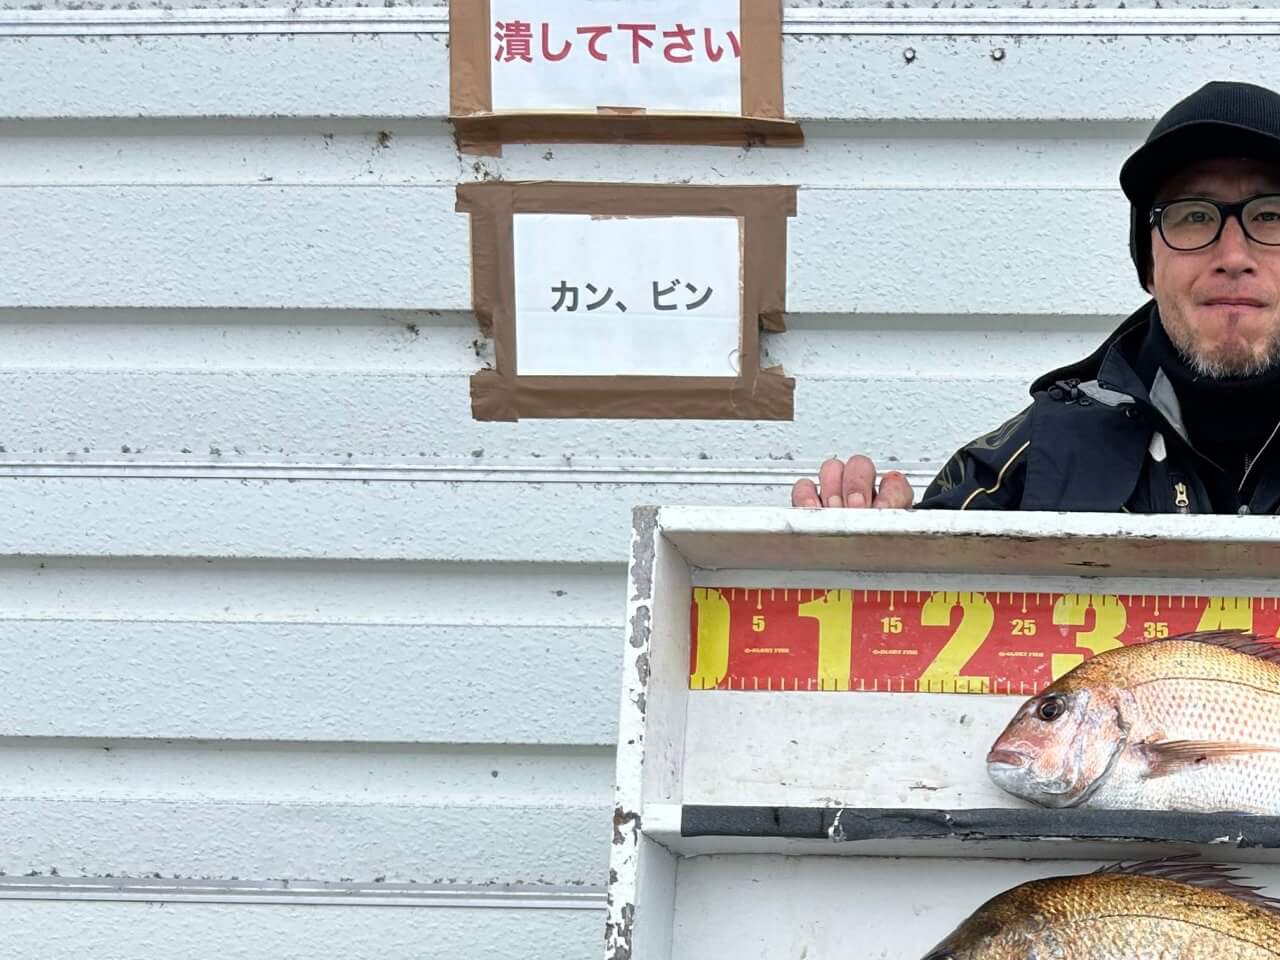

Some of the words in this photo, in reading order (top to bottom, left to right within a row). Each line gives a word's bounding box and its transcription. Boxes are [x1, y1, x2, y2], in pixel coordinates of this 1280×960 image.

[494, 21, 742, 64] 潰して下さい
[551, 279, 714, 313] カン、ビン
[752, 615, 765, 632] 5
[799, 589, 853, 691] 1
[881, 617, 902, 633] 15
[918, 591, 994, 694] 2
[1011, 619, 1037, 636] 25
[1052, 593, 1127, 682] 3
[1143, 622, 1169, 639] 35
